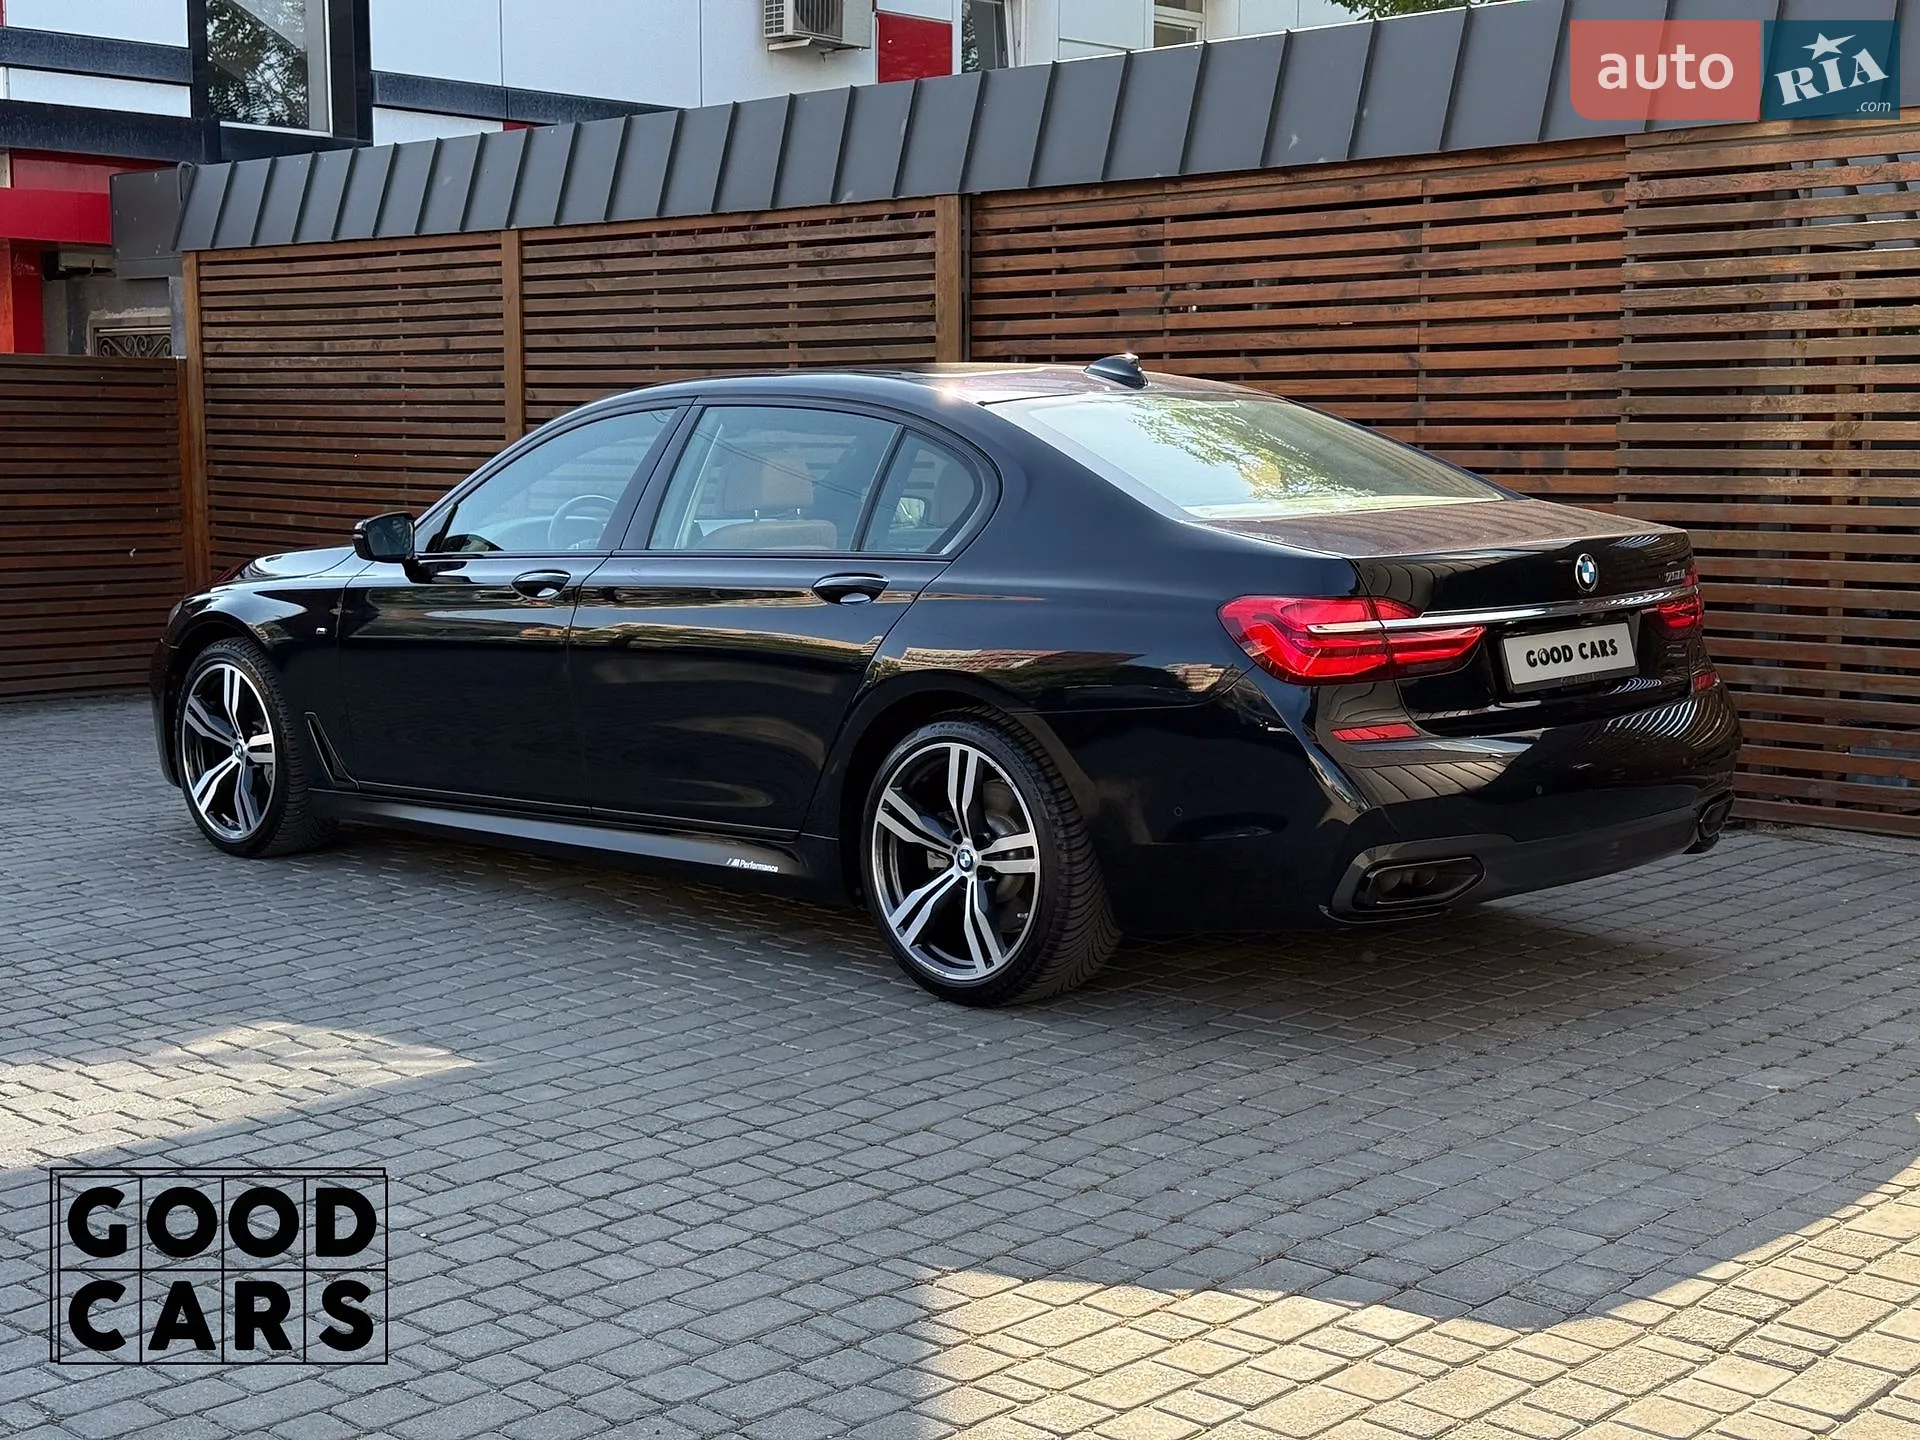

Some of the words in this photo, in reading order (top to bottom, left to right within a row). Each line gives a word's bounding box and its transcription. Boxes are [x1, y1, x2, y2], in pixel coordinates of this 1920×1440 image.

[1525, 644, 1574, 668] GOOD
[1578, 638, 1618, 660] CARS
[740, 860, 779, 873] Performance
